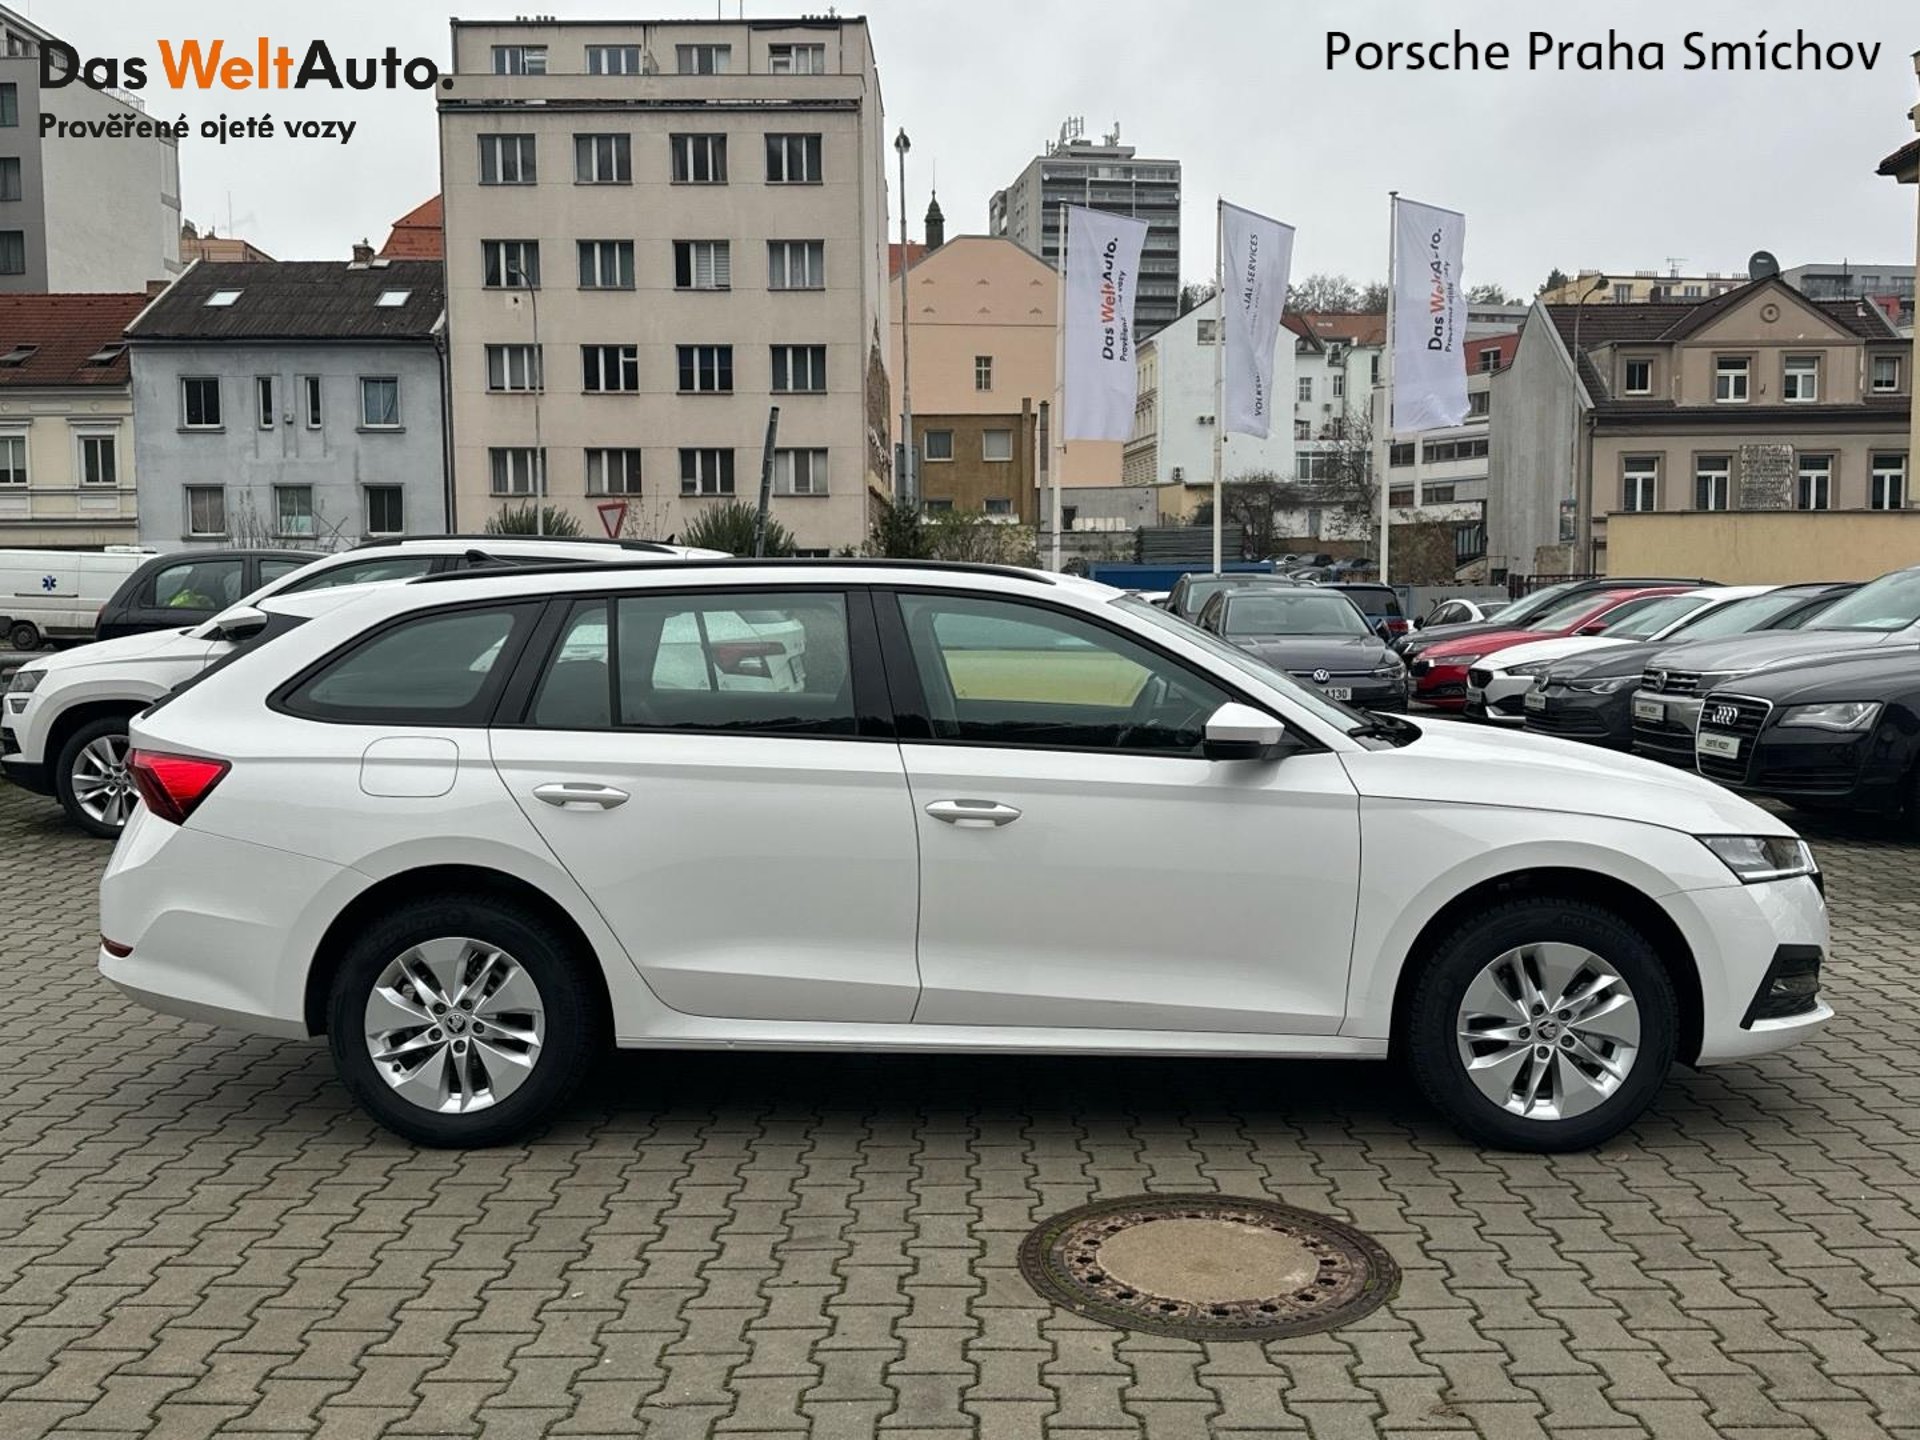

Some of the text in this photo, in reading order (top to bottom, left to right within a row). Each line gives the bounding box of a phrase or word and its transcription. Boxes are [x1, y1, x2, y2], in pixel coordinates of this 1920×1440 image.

[1246, 234, 1258, 283] SERVICES
[1103, 328, 1114, 360] Das
[1428, 317, 1444, 350] Das
